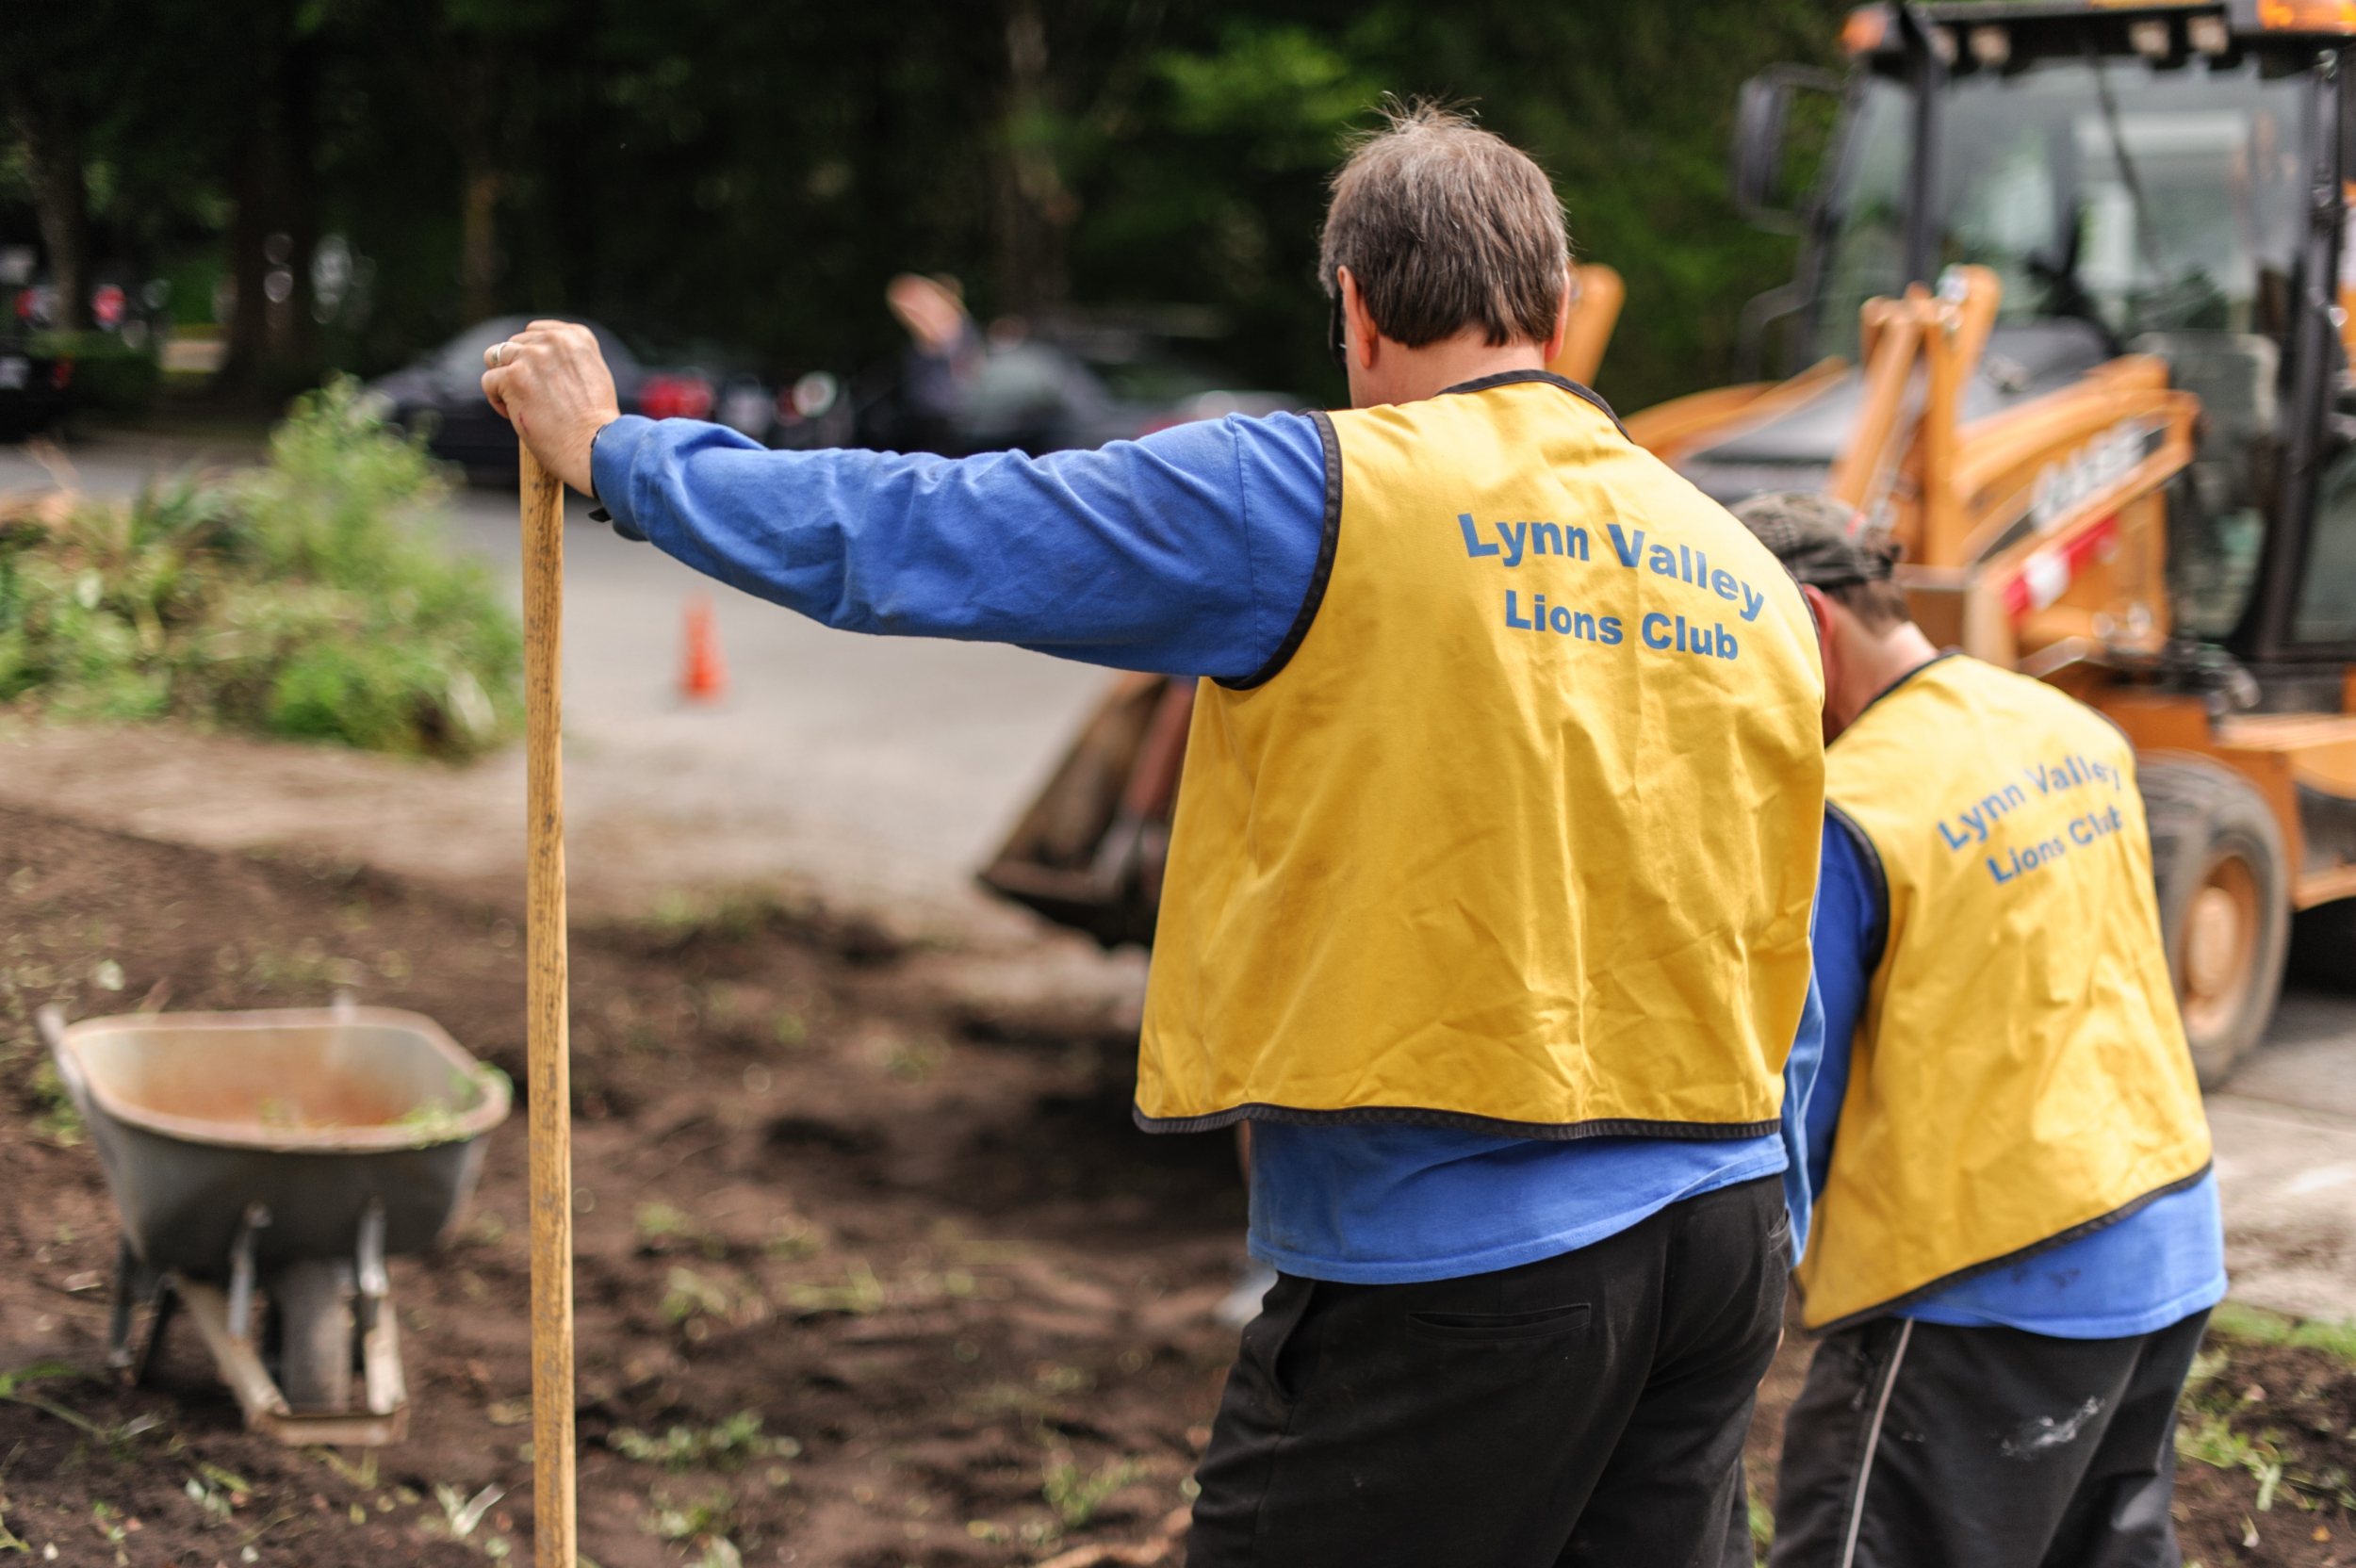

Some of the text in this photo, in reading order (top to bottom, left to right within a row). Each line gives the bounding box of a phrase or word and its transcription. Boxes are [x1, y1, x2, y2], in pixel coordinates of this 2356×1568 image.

[1457, 513, 1764, 622] Lynn Valley
[1505, 589, 1739, 661] Lions Club
[1937, 781, 2026, 852] Lynn
[1986, 836, 2066, 886] Lions
